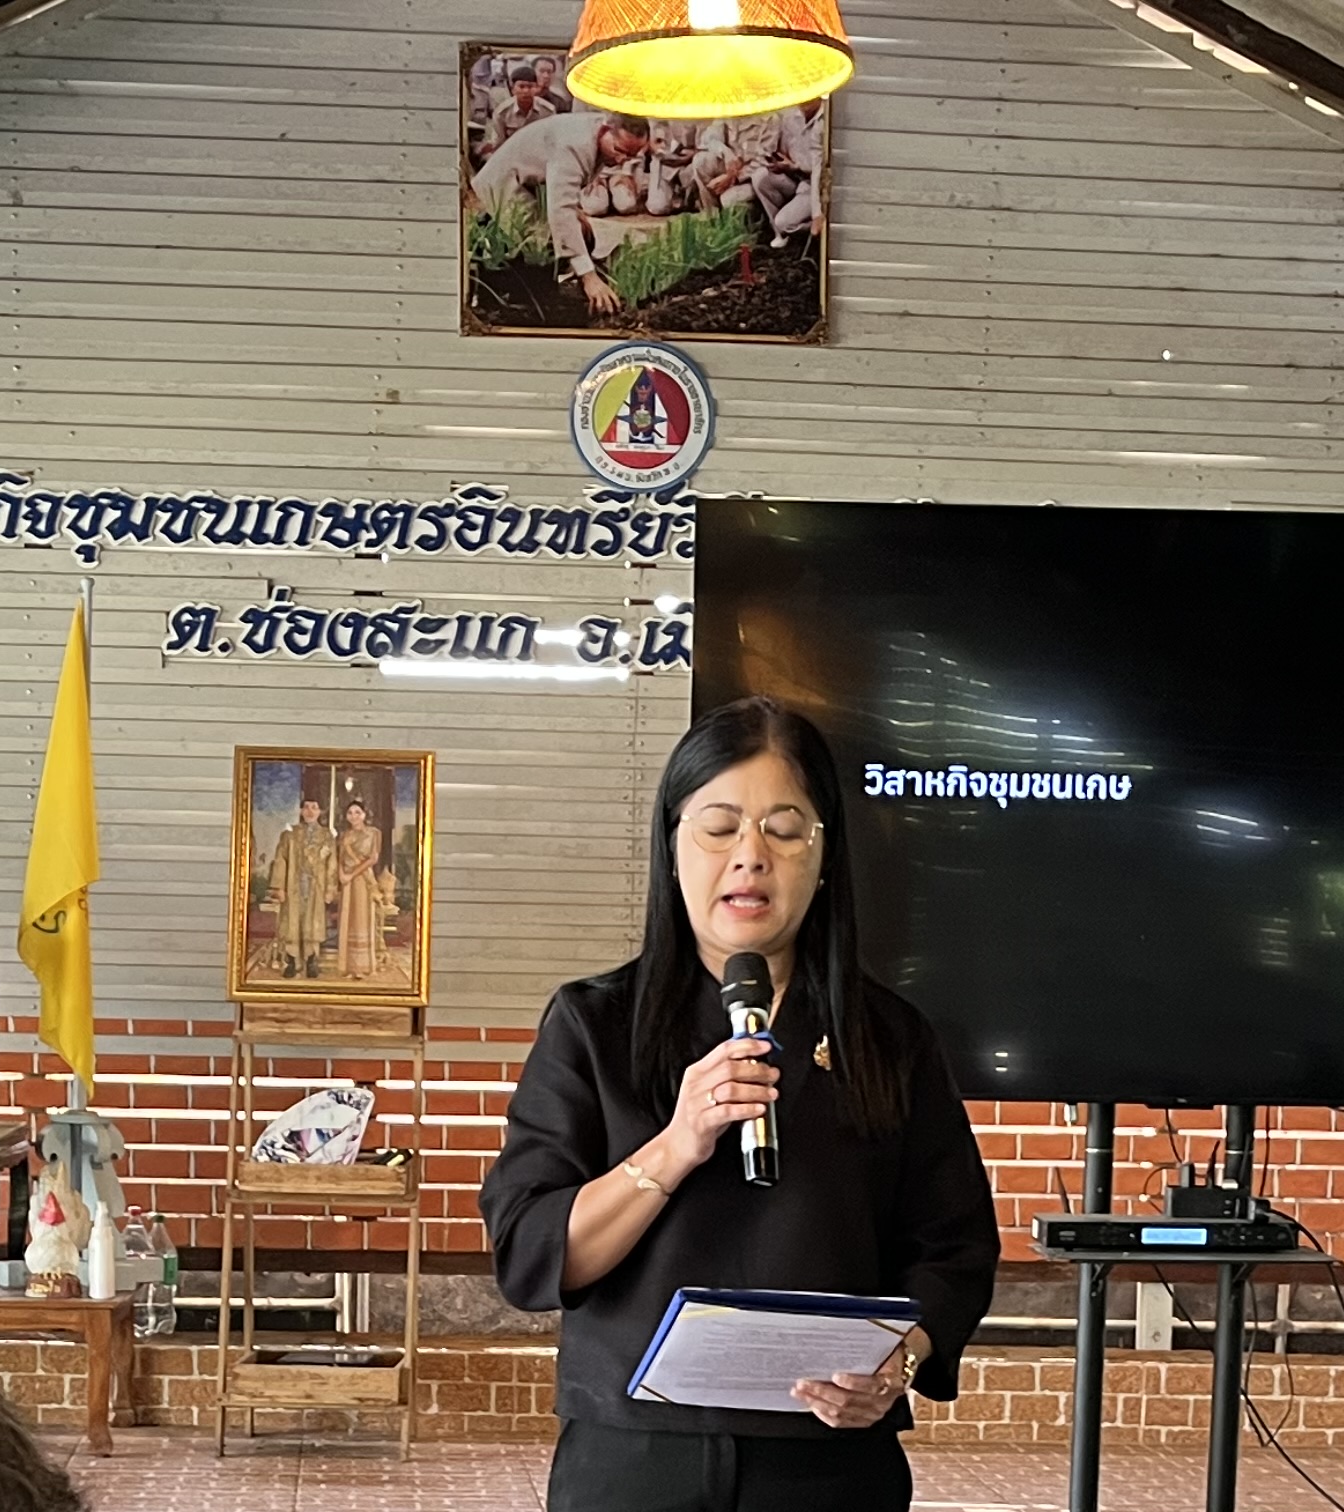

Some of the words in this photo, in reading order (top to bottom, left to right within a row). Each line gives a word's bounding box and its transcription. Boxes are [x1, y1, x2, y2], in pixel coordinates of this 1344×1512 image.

[164, 587, 541, 661] ต.ช่องสะแก
[864, 763, 1133, 809] วิสาหกิจชุมชนเกษ
